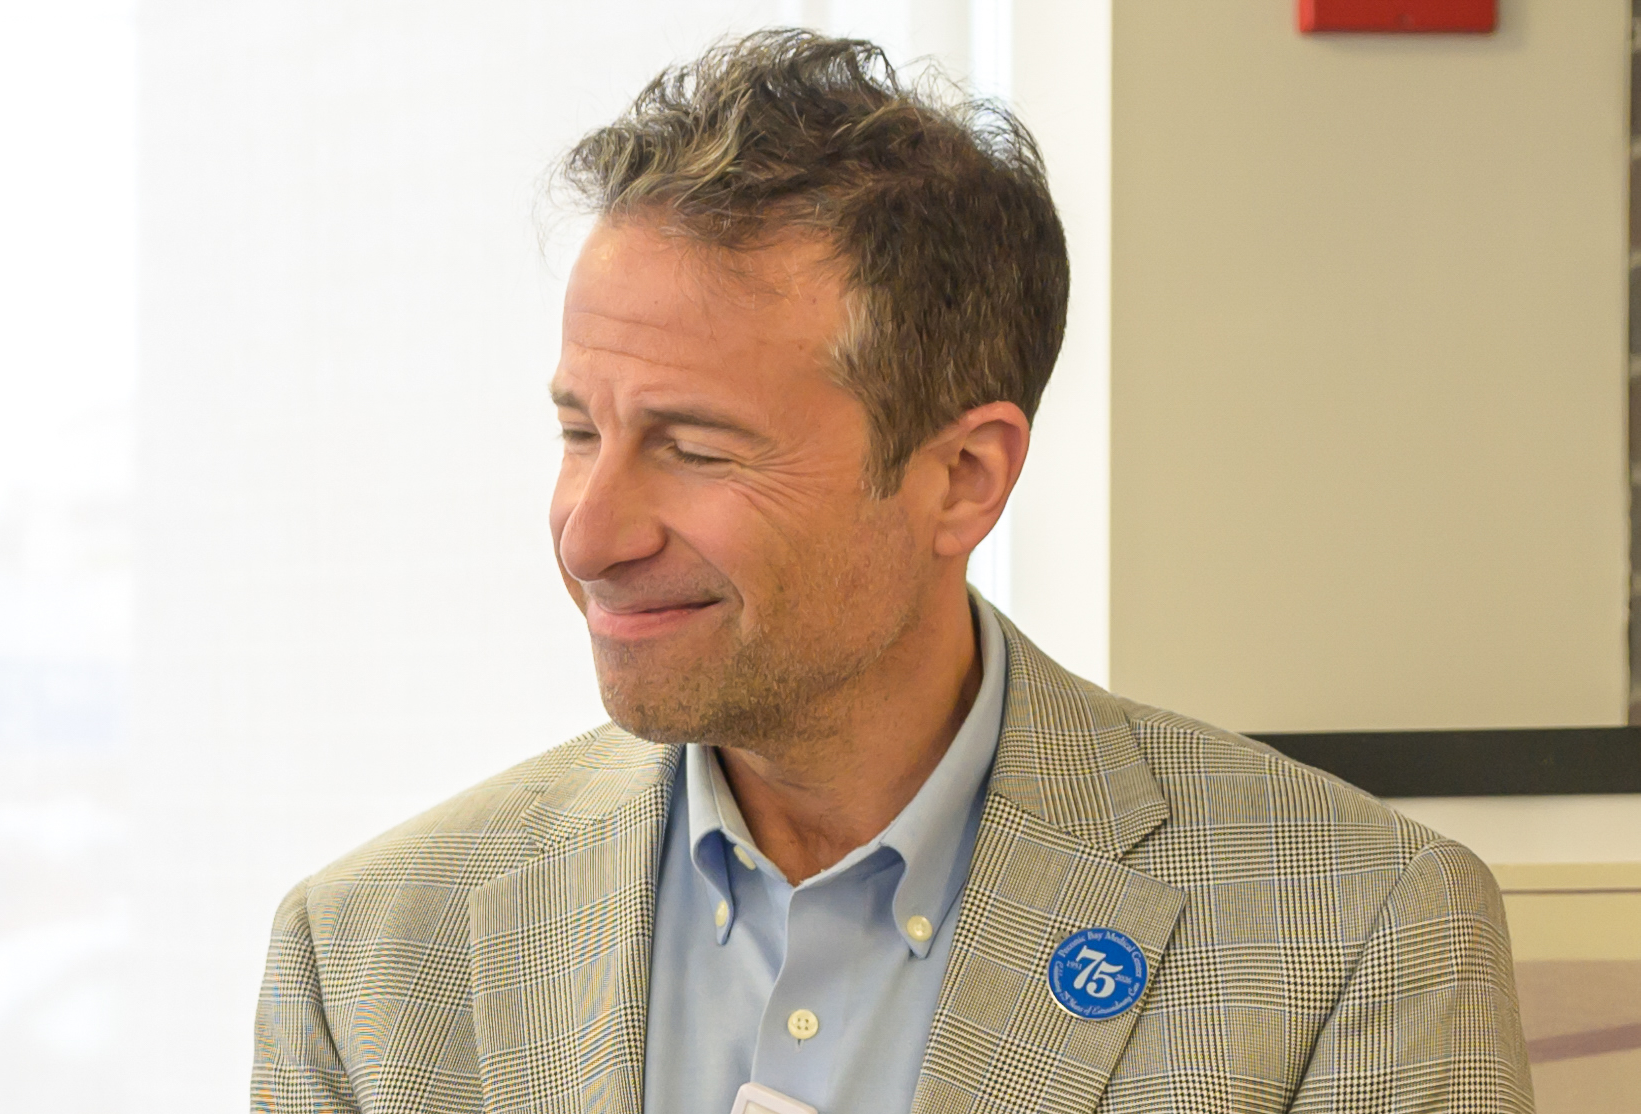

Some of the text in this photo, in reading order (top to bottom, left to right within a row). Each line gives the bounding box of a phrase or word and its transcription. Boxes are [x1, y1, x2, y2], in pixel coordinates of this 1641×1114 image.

[1087, 931, 1103, 940] Bay
[1105, 931, 1135, 952] Medical
[1073, 945, 1124, 998] 75
